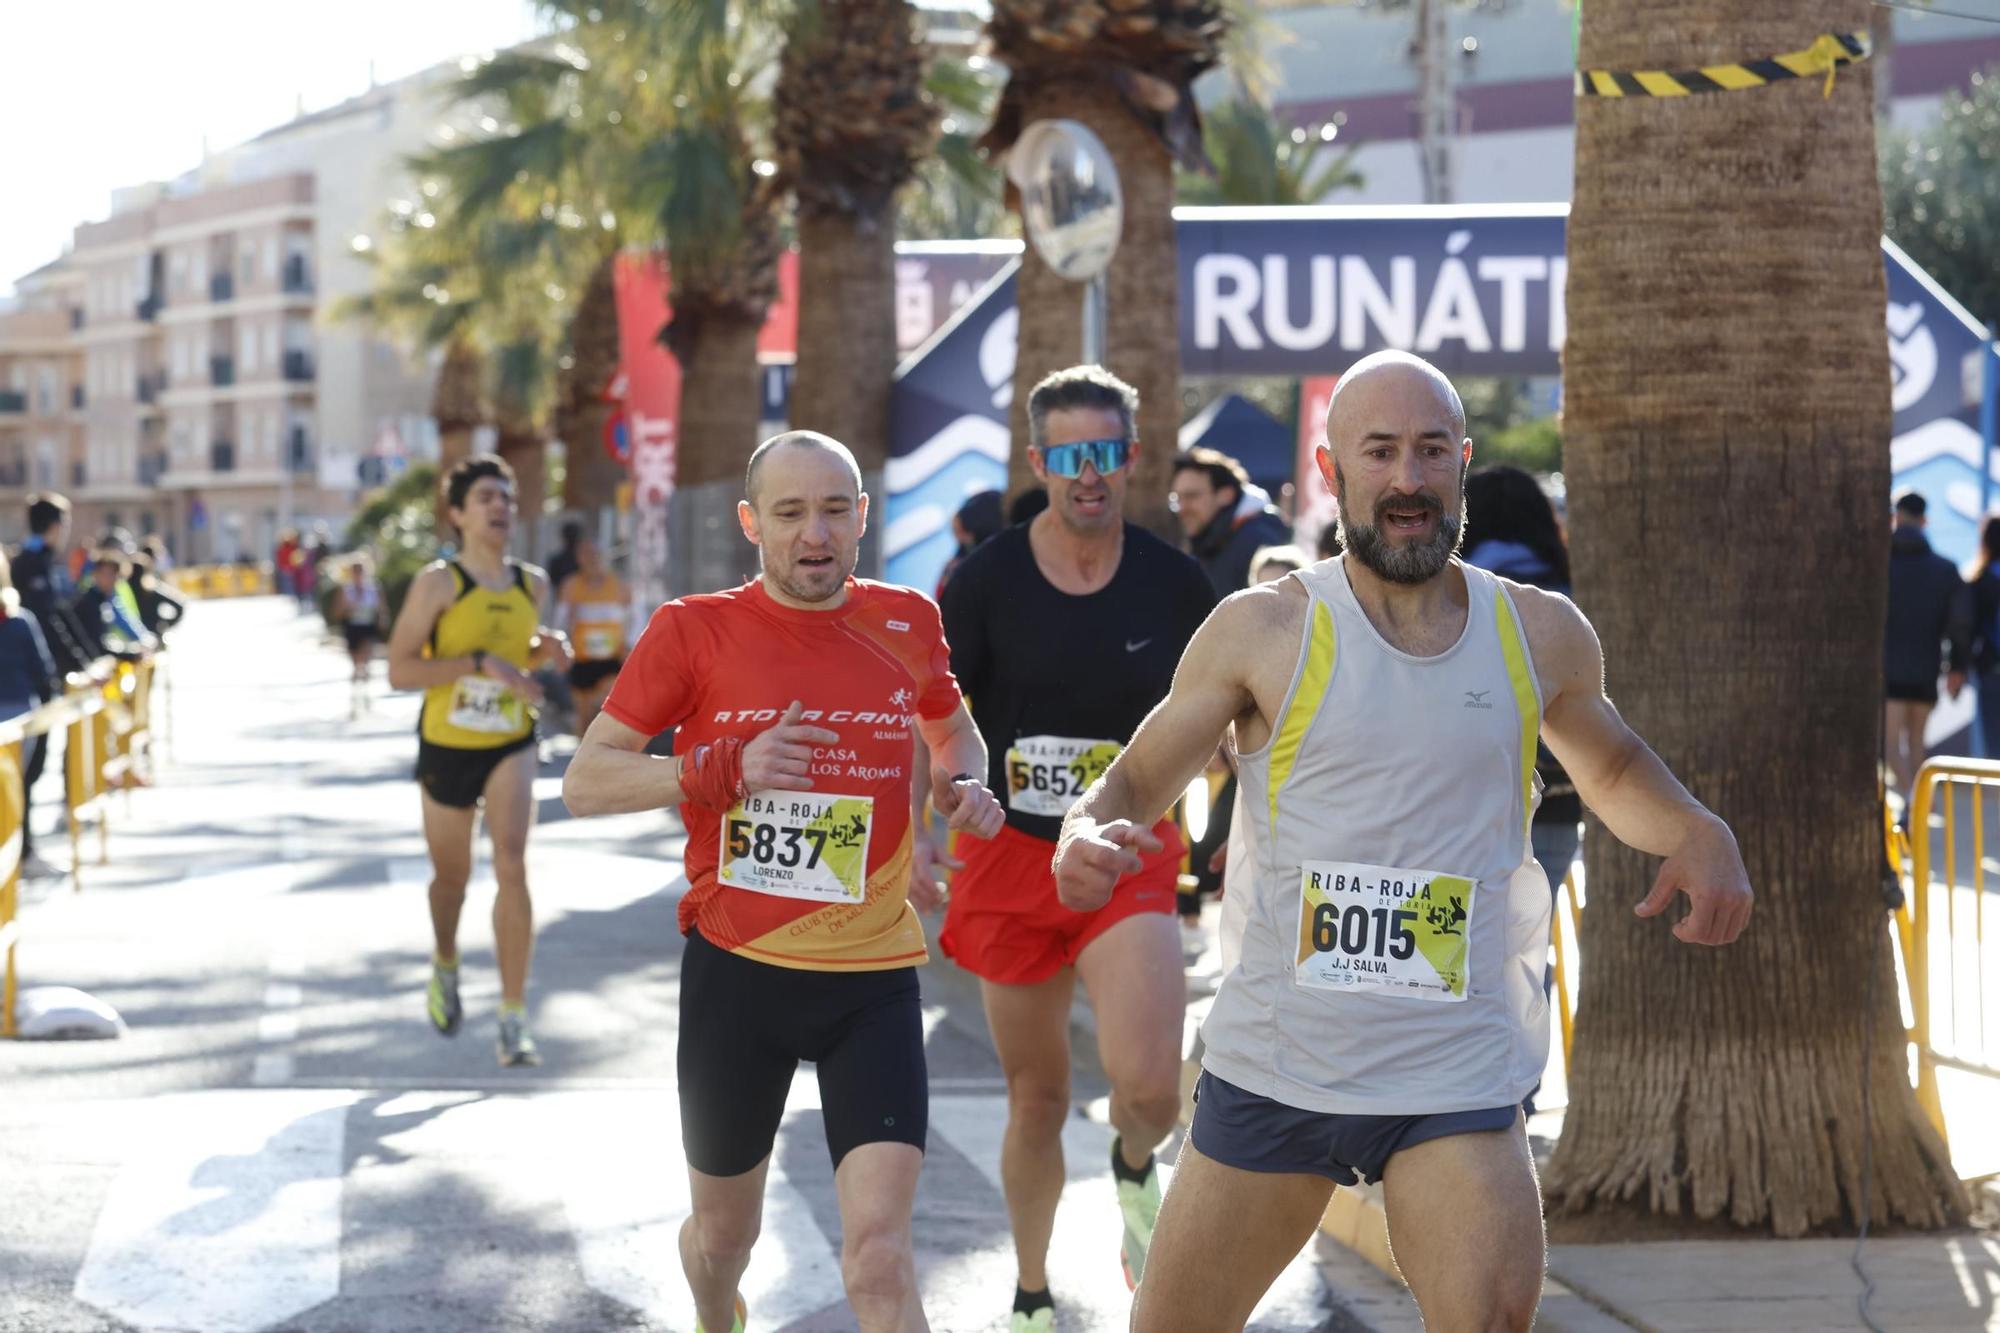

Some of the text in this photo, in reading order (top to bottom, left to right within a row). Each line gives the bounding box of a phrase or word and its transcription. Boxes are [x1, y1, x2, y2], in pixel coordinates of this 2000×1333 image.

[813, 748, 857, 761] CASA
[812, 764, 902, 780] LOS AROMAS
[1012, 761, 1087, 797] 5652
[729, 819, 828, 870] 5837
[753, 865, 794, 881] LORENZO
[1311, 872, 1431, 900] RIBA-ROJA
[790, 915, 822, 937] CLUB
[1312, 902, 1418, 961] 6015
[1353, 958, 1388, 974] SALVA
